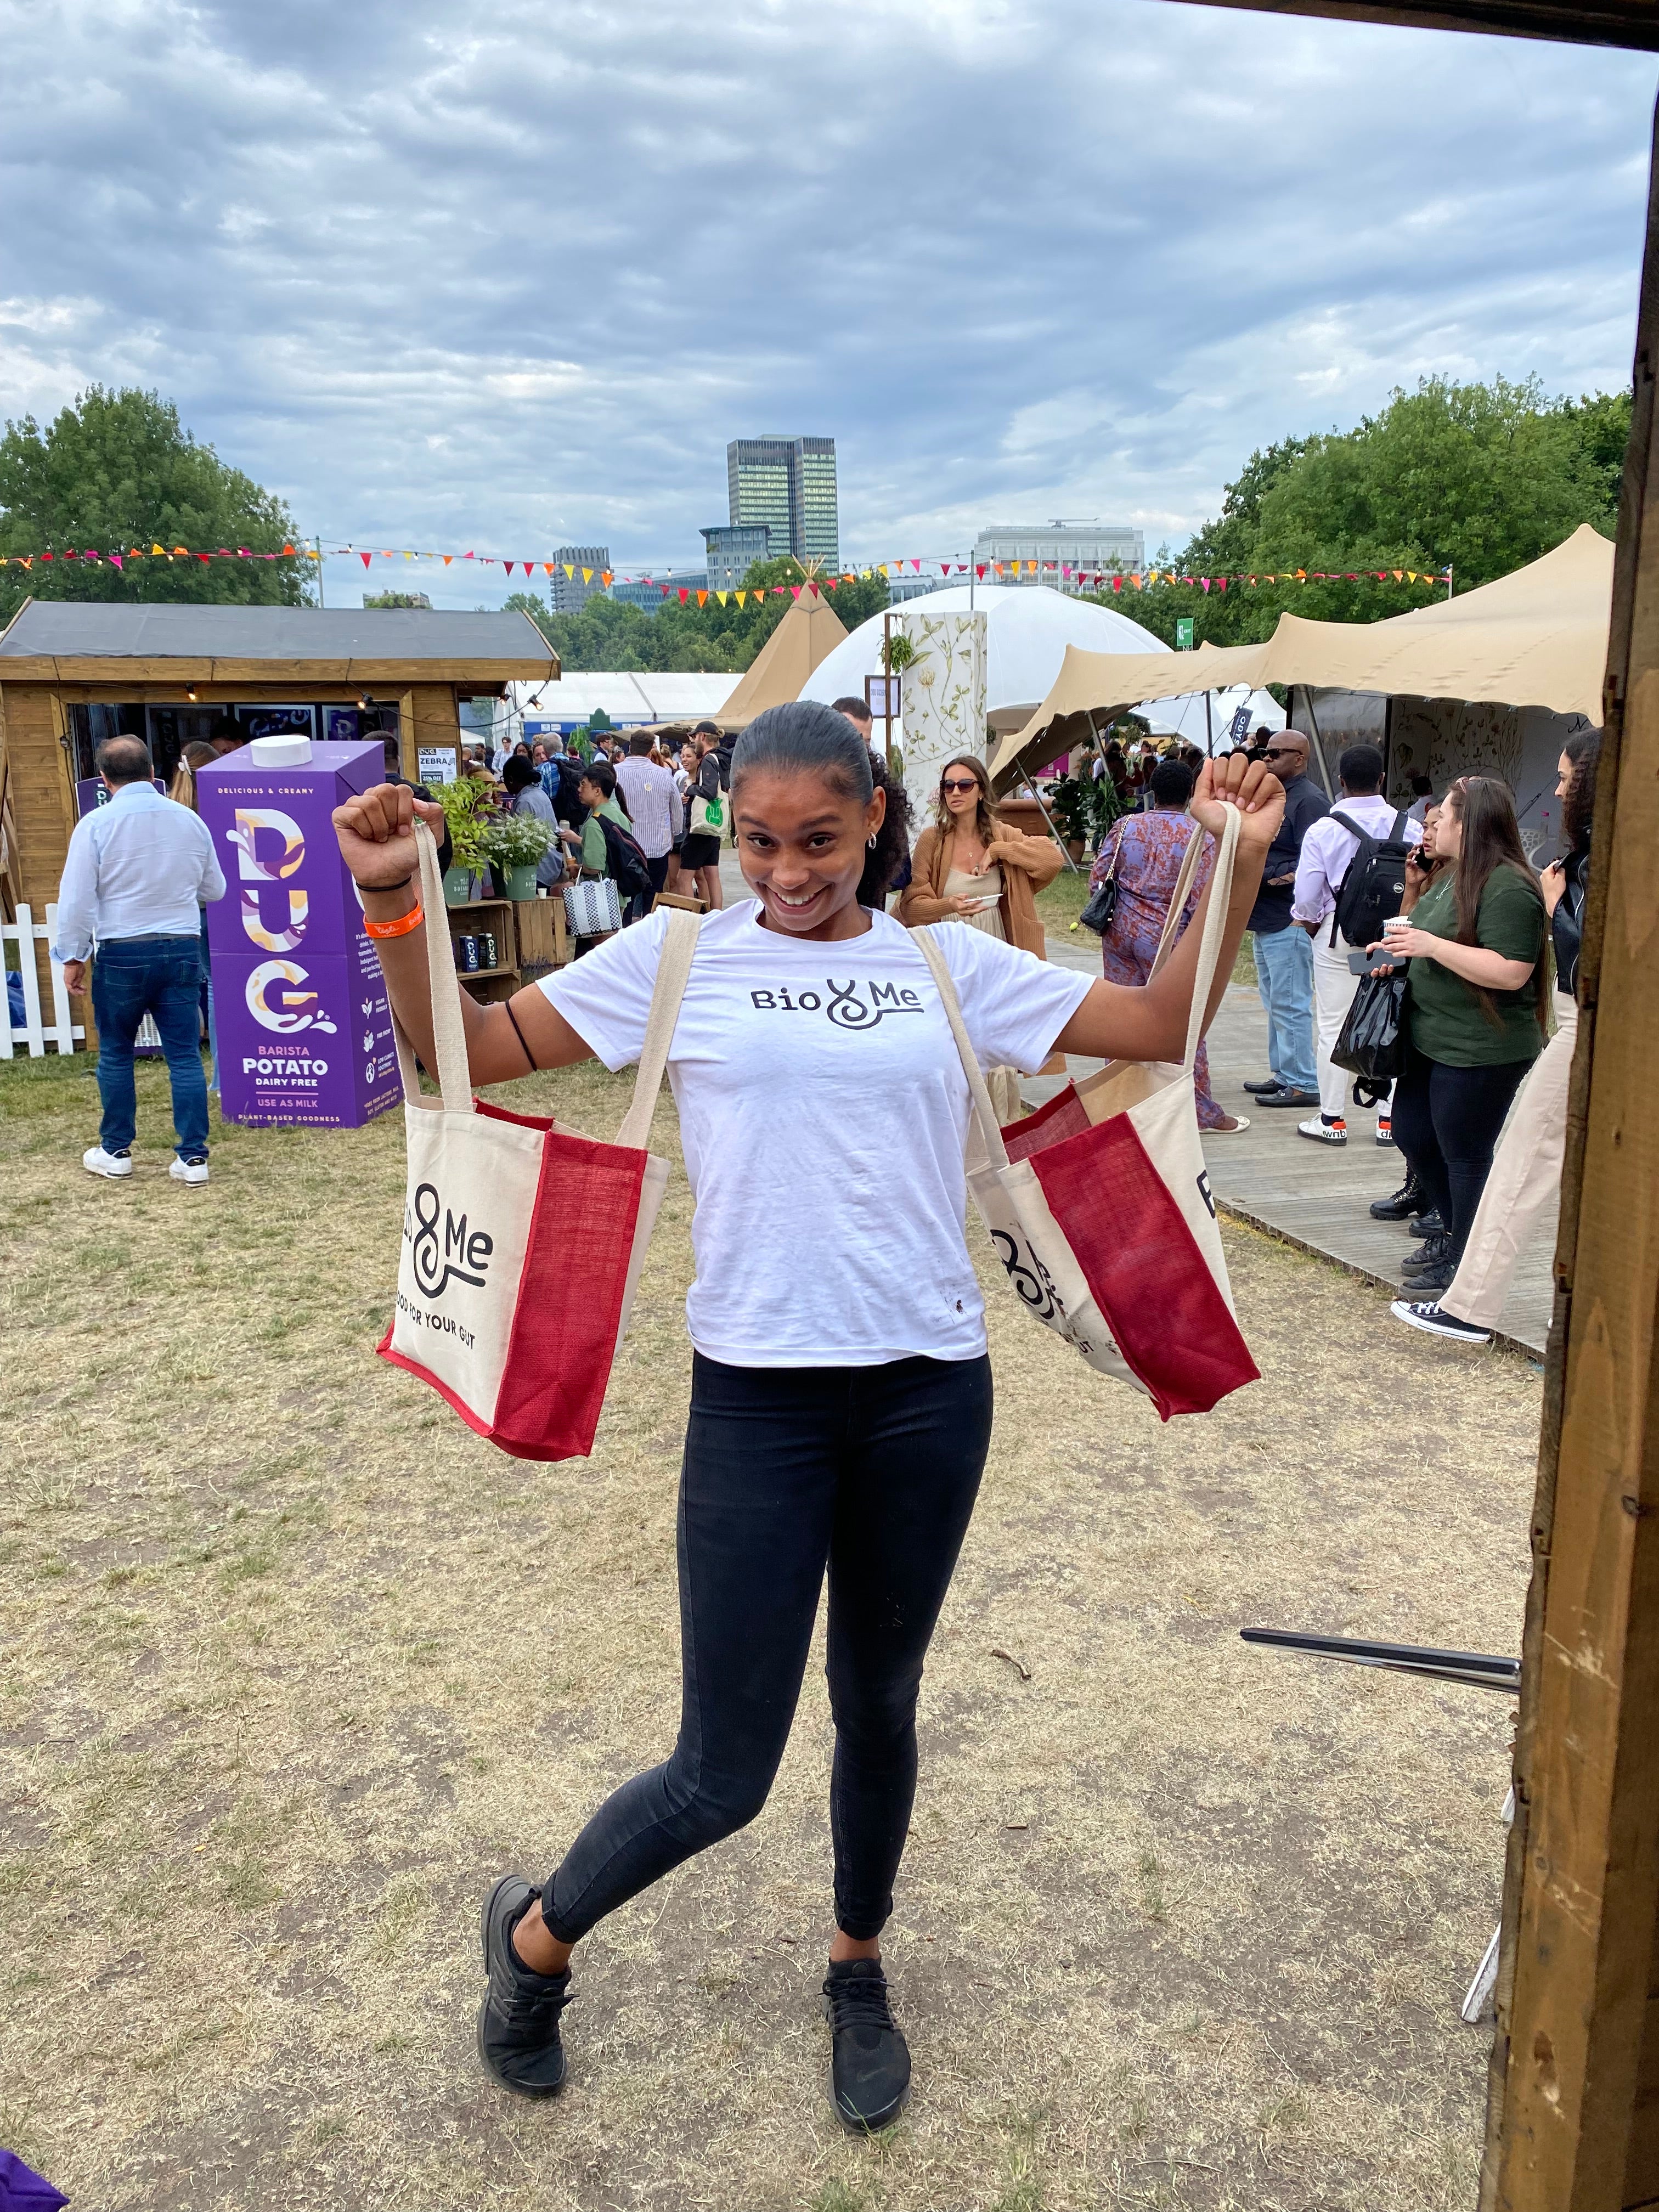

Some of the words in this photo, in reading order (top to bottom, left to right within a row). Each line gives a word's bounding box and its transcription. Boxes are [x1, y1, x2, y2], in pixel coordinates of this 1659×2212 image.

[467, 941, 478, 963] DUG
[488, 939, 497, 961] DUG
[258, 1046, 310, 1056] BARISTA
[242, 1058, 328, 1076] POTATO
[255, 1077, 288, 1086] DAIRY
[291, 1079, 318, 1087] FREE
[257, 1099, 277, 1107] USE
[296, 1099, 318, 1108] MILK
[445, 1208, 493, 1270] Me
[397, 1290, 408, 1312] OOD
[409, 1302, 422, 1326] FOR
[425, 1312, 457, 1336] YOUR
[459, 1325, 476, 1350] GUT
